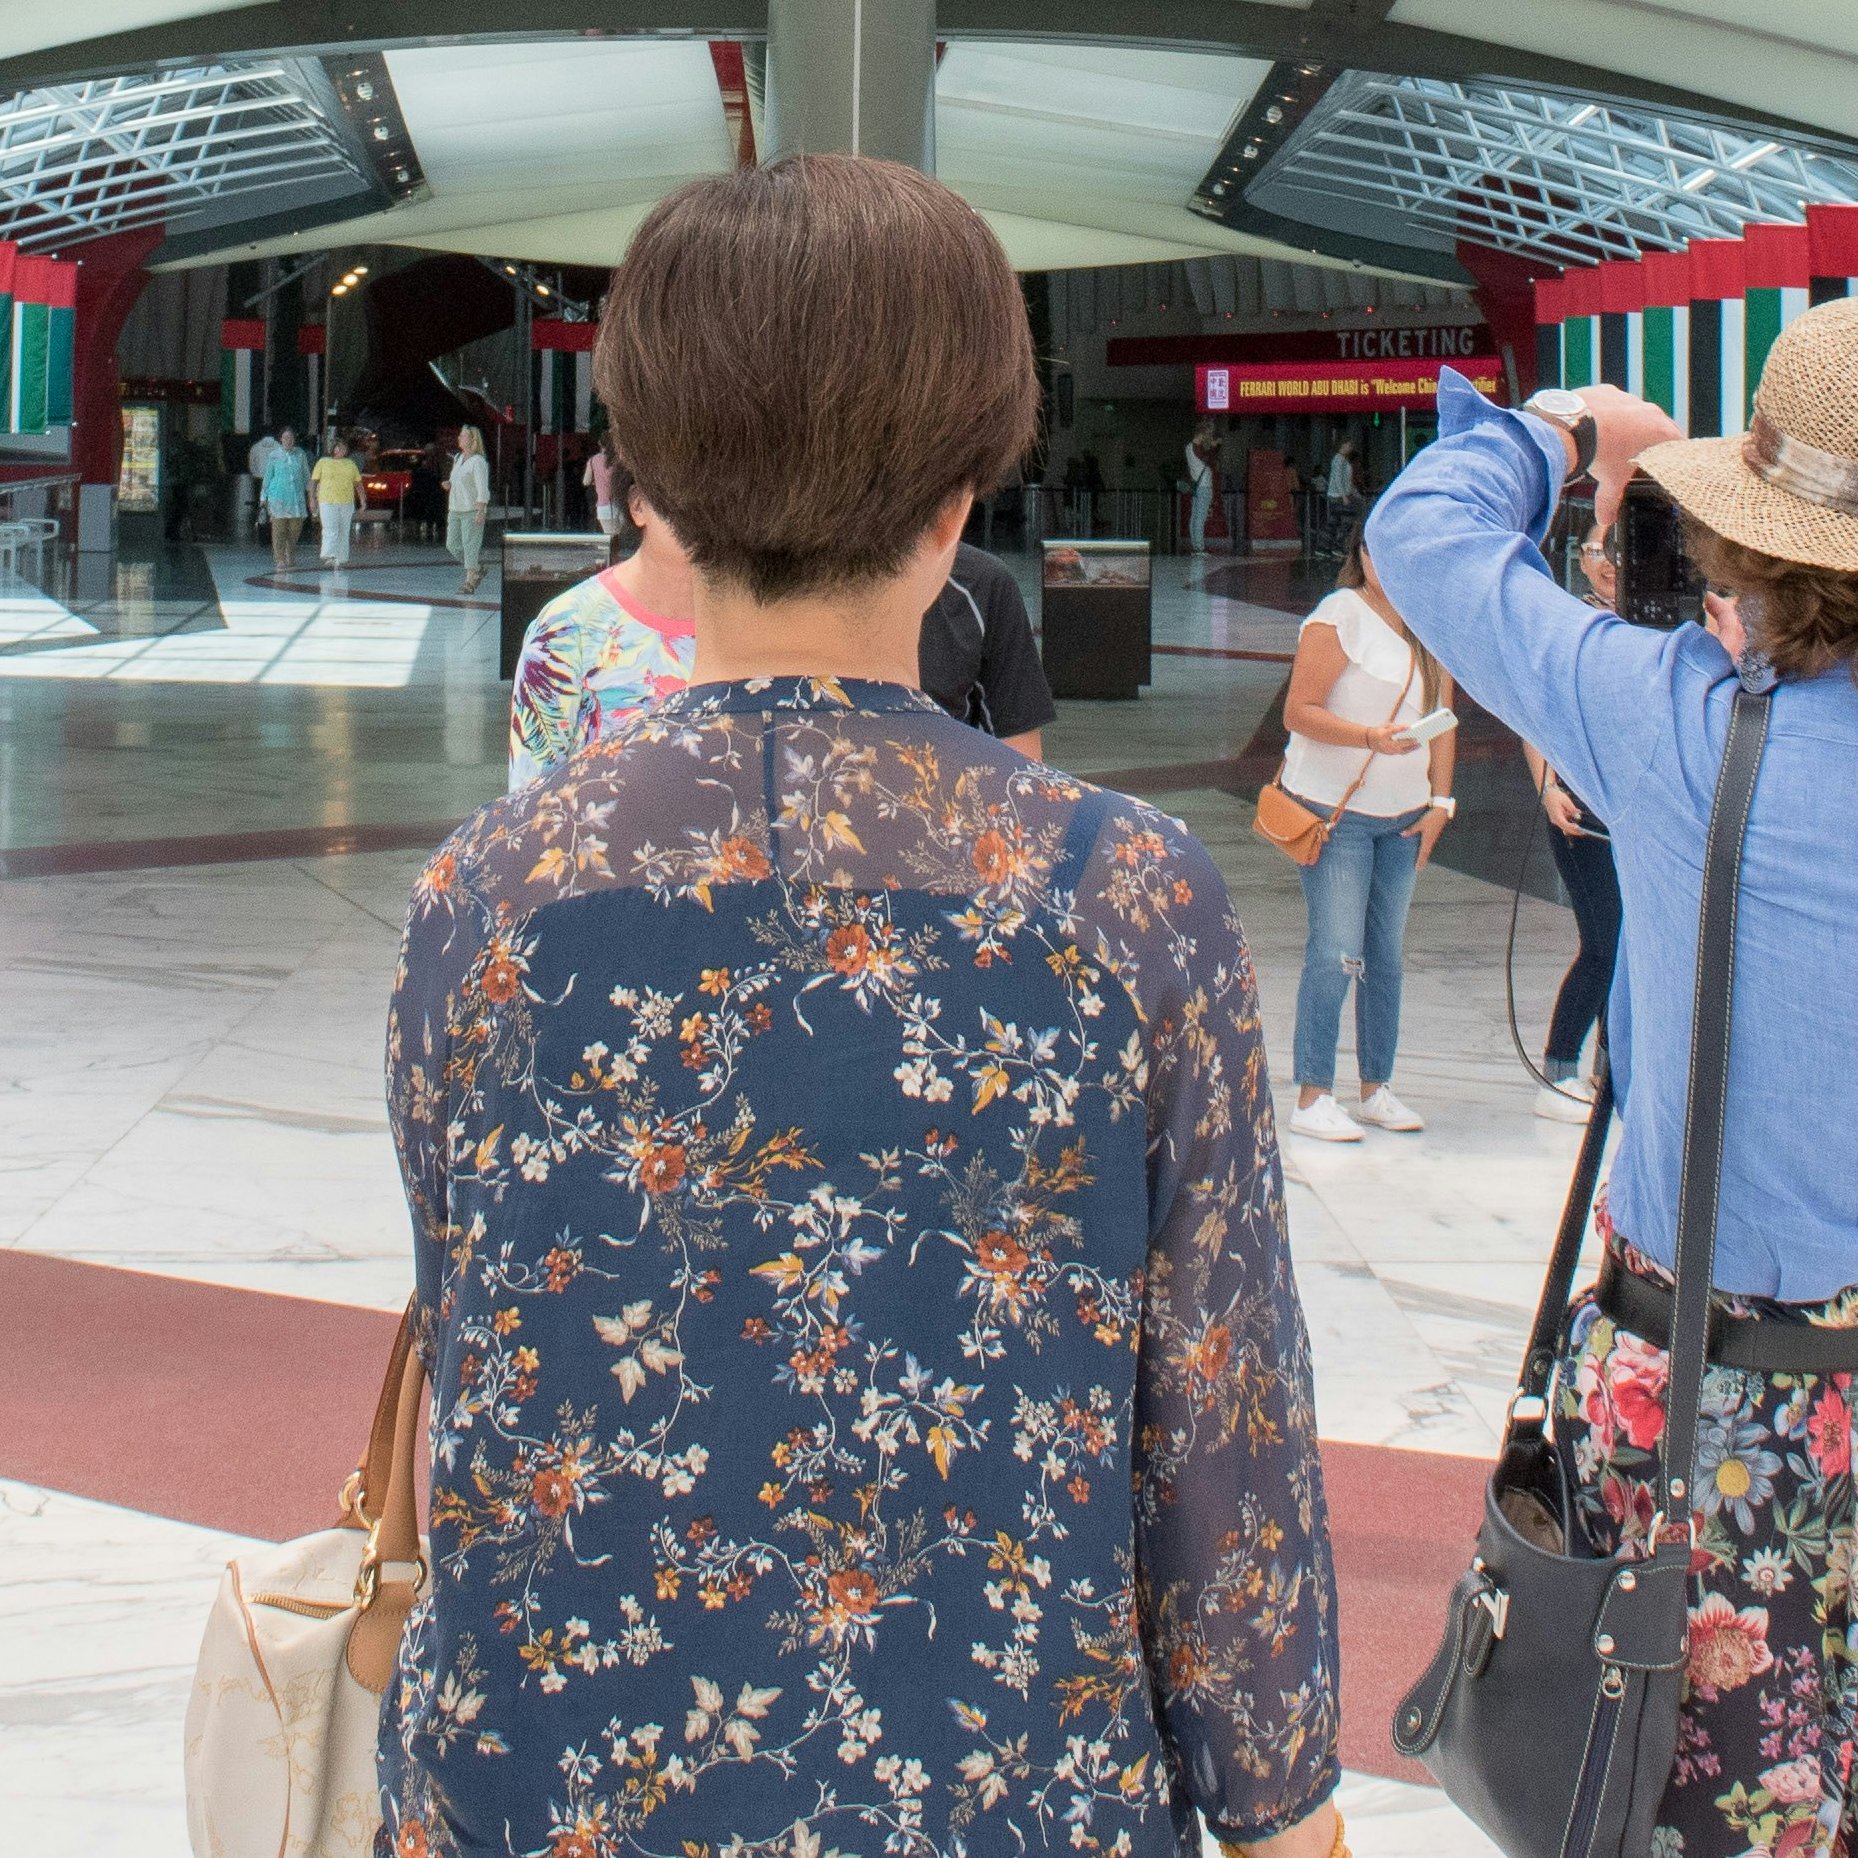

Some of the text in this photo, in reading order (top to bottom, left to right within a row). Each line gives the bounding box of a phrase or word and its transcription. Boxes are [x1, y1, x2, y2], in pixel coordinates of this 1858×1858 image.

[1336, 328, 1474, 358] TICKETING
[1240, 381, 1276, 397] FERRARI
[1278, 380, 1309, 396] WORLD
[1311, 380, 1329, 395] ABU
[1331, 379, 1358, 395] DHABI
[1360, 379, 1369, 395] is
